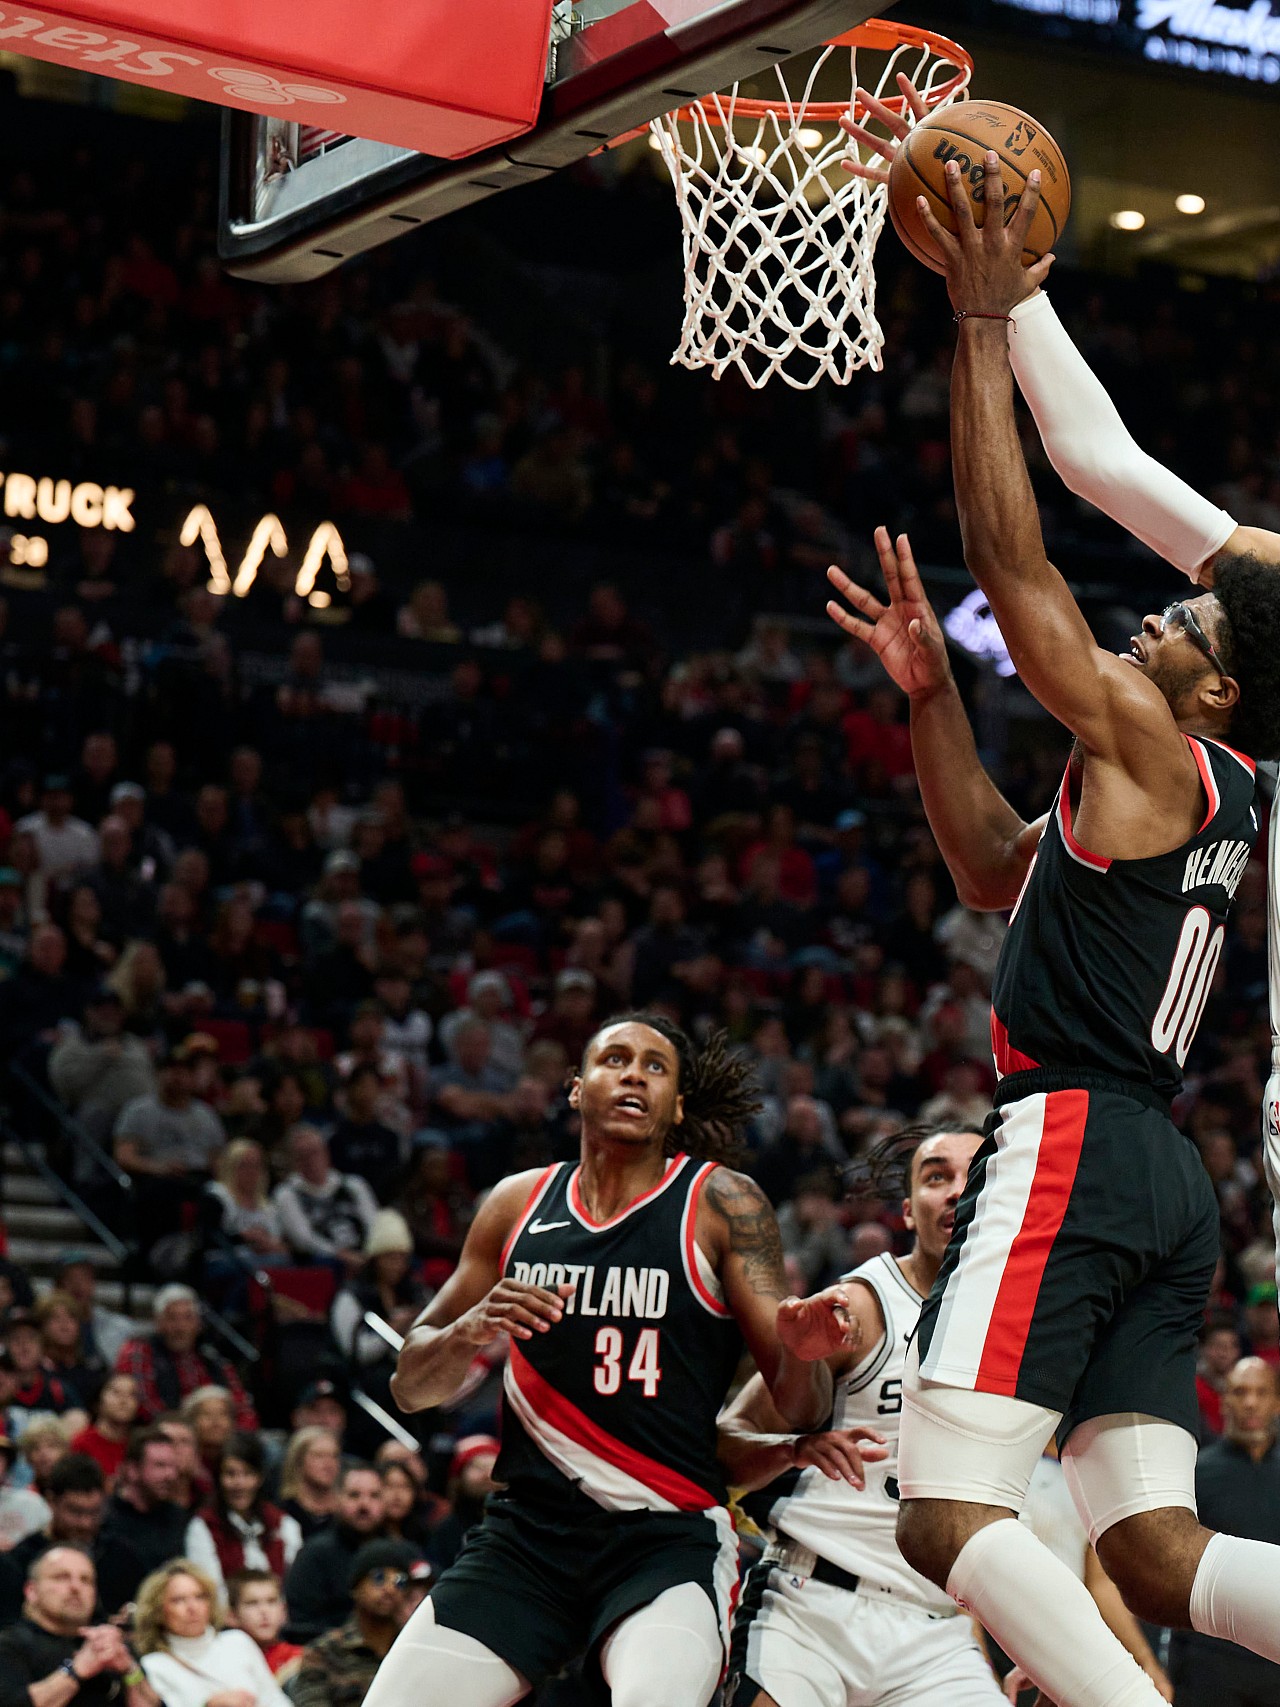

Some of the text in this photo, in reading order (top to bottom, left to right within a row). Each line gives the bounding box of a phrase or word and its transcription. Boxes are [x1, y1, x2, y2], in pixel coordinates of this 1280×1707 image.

[0, 10, 202, 76] Stat
[0, 472, 135, 532] RUCK
[1151, 905, 1225, 1069] 00
[593, 1325, 662, 1397] 34
